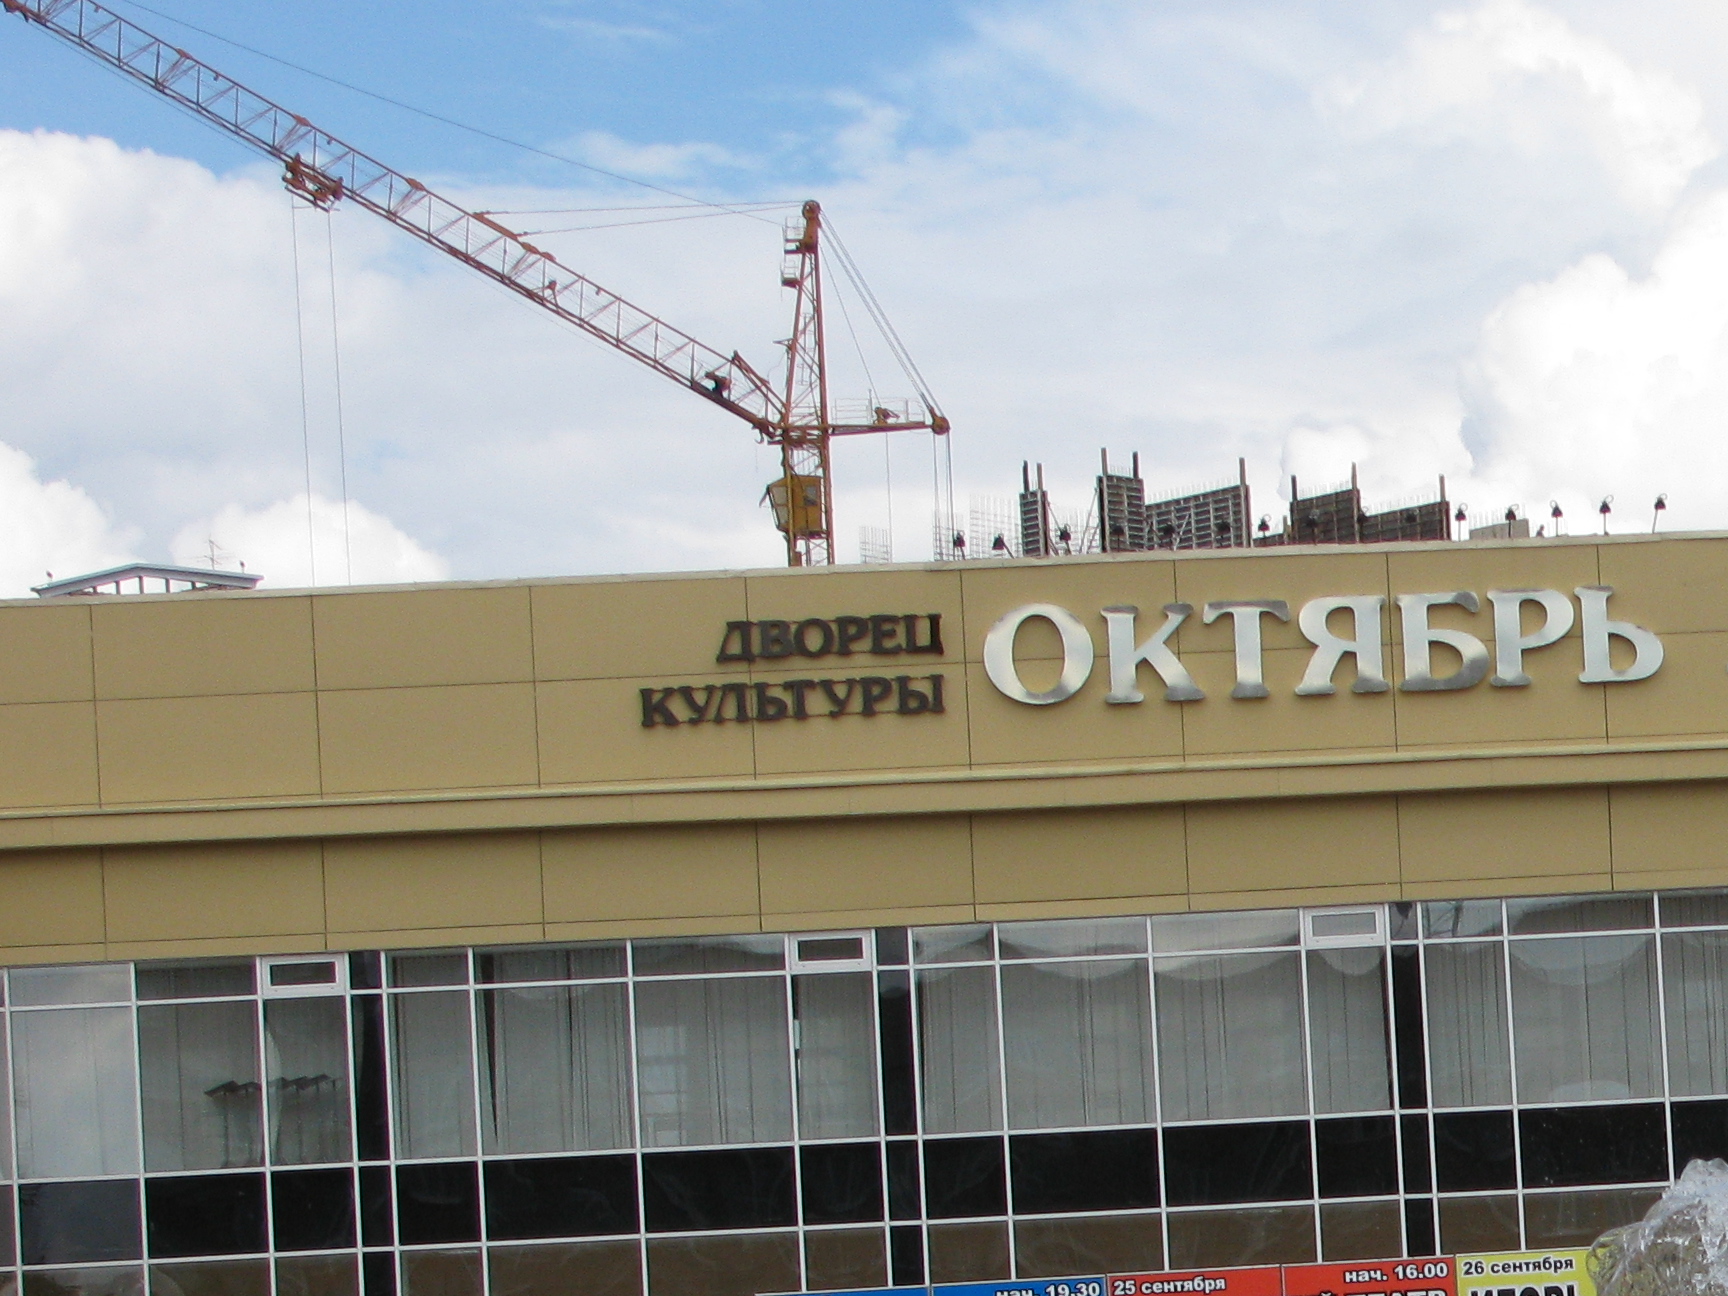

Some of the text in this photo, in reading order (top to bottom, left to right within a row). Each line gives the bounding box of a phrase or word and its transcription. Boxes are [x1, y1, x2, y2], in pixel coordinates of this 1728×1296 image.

[716, 613, 945, 664] ДВОРЕЦ
[982, 584, 1665, 705] ОКТЯБРЬ
[639, 673, 946, 728] КУЛЬТУРЫ
[1344, 1262, 1449, 1284] нач. 16.00
[1462, 1256, 1575, 1277] 26 сентября
[1113, 1275, 1227, 1296] 25 сентября
